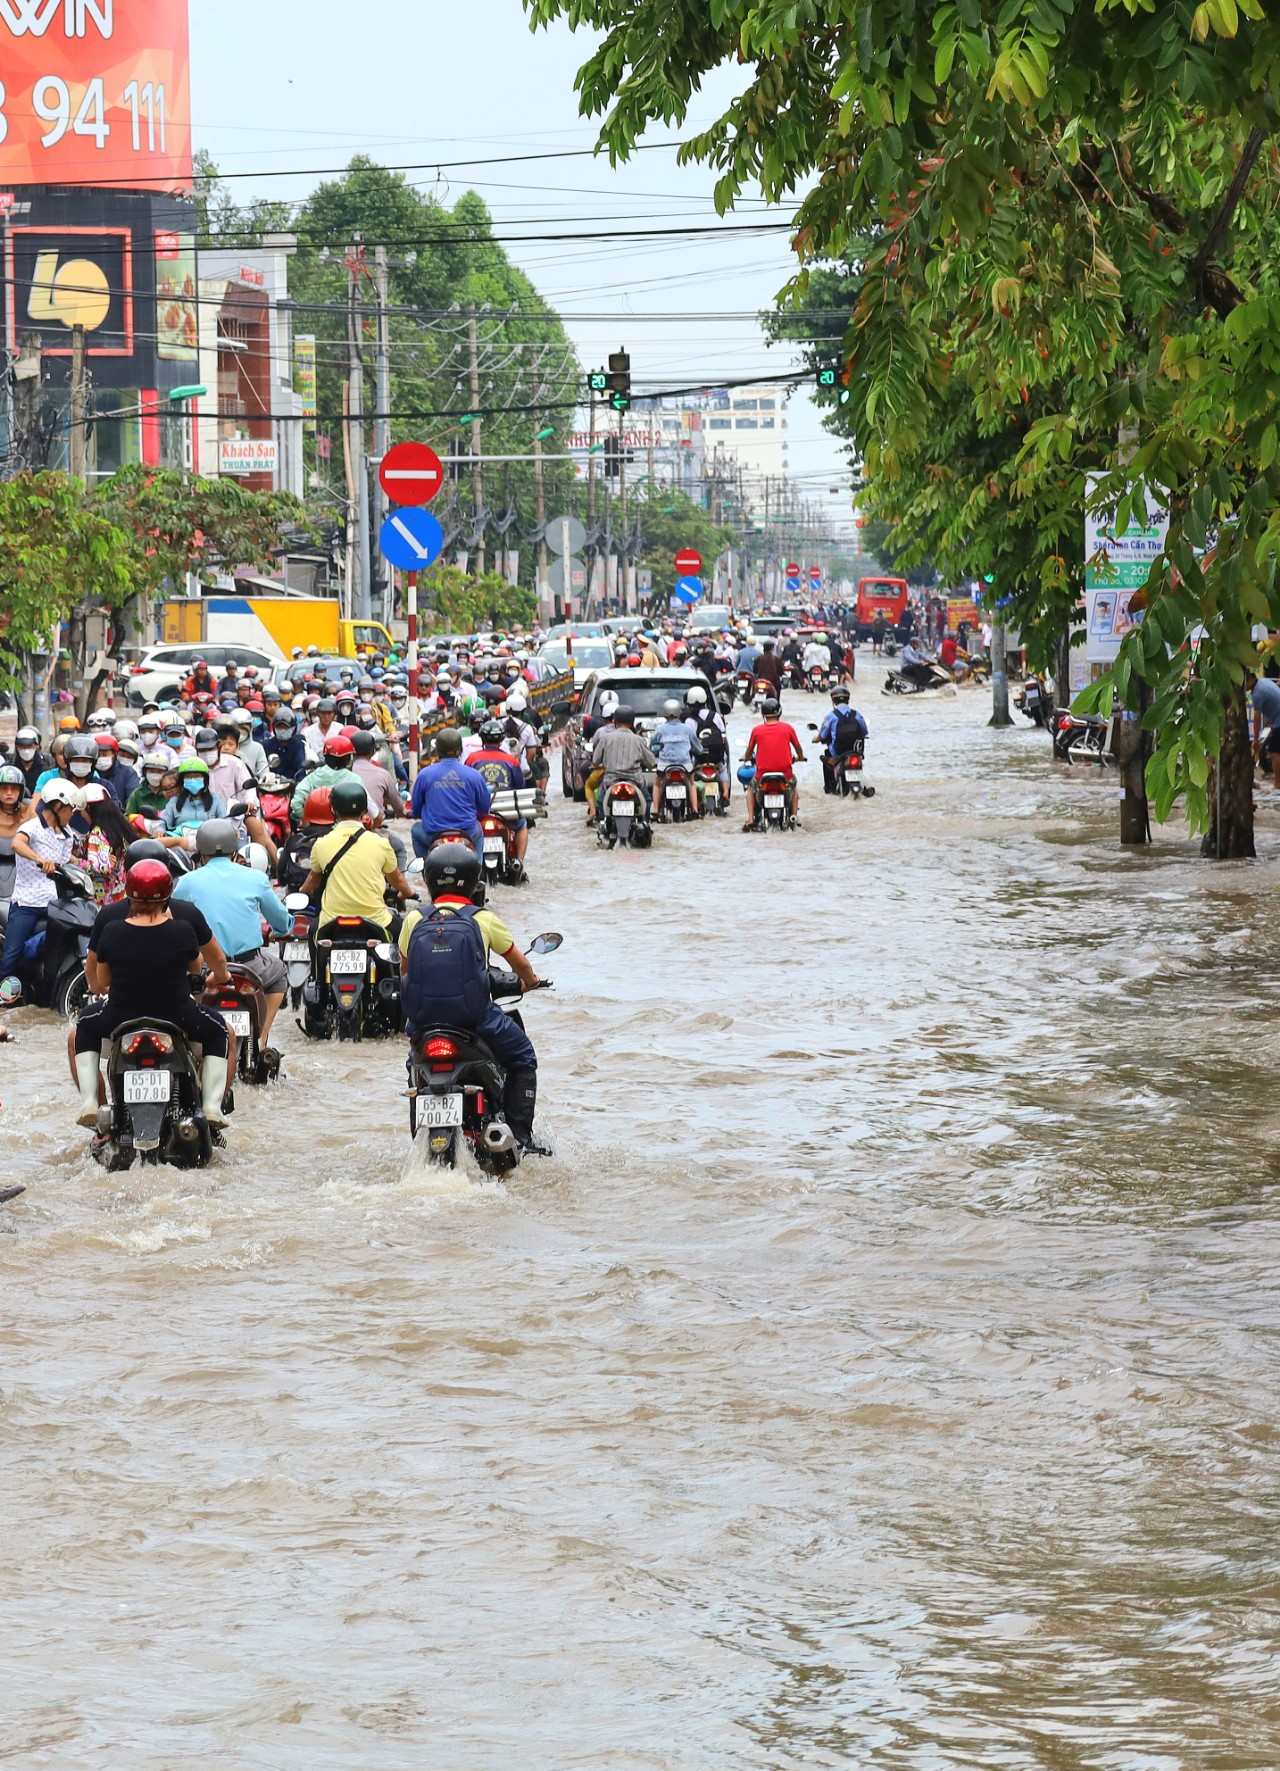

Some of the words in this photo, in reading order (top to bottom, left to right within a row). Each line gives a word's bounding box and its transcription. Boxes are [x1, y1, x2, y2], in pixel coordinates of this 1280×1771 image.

[32, 74, 111, 149] 94
[123, 79, 166, 154] 111
[591, 374, 606, 388] 20
[819, 370, 835, 384] 20
[222, 442, 255, 458] Khách
[333, 962, 364, 972] 775.99
[128, 1088, 167, 1101] 107.86
[419, 1110, 460, 1126] 700.24
